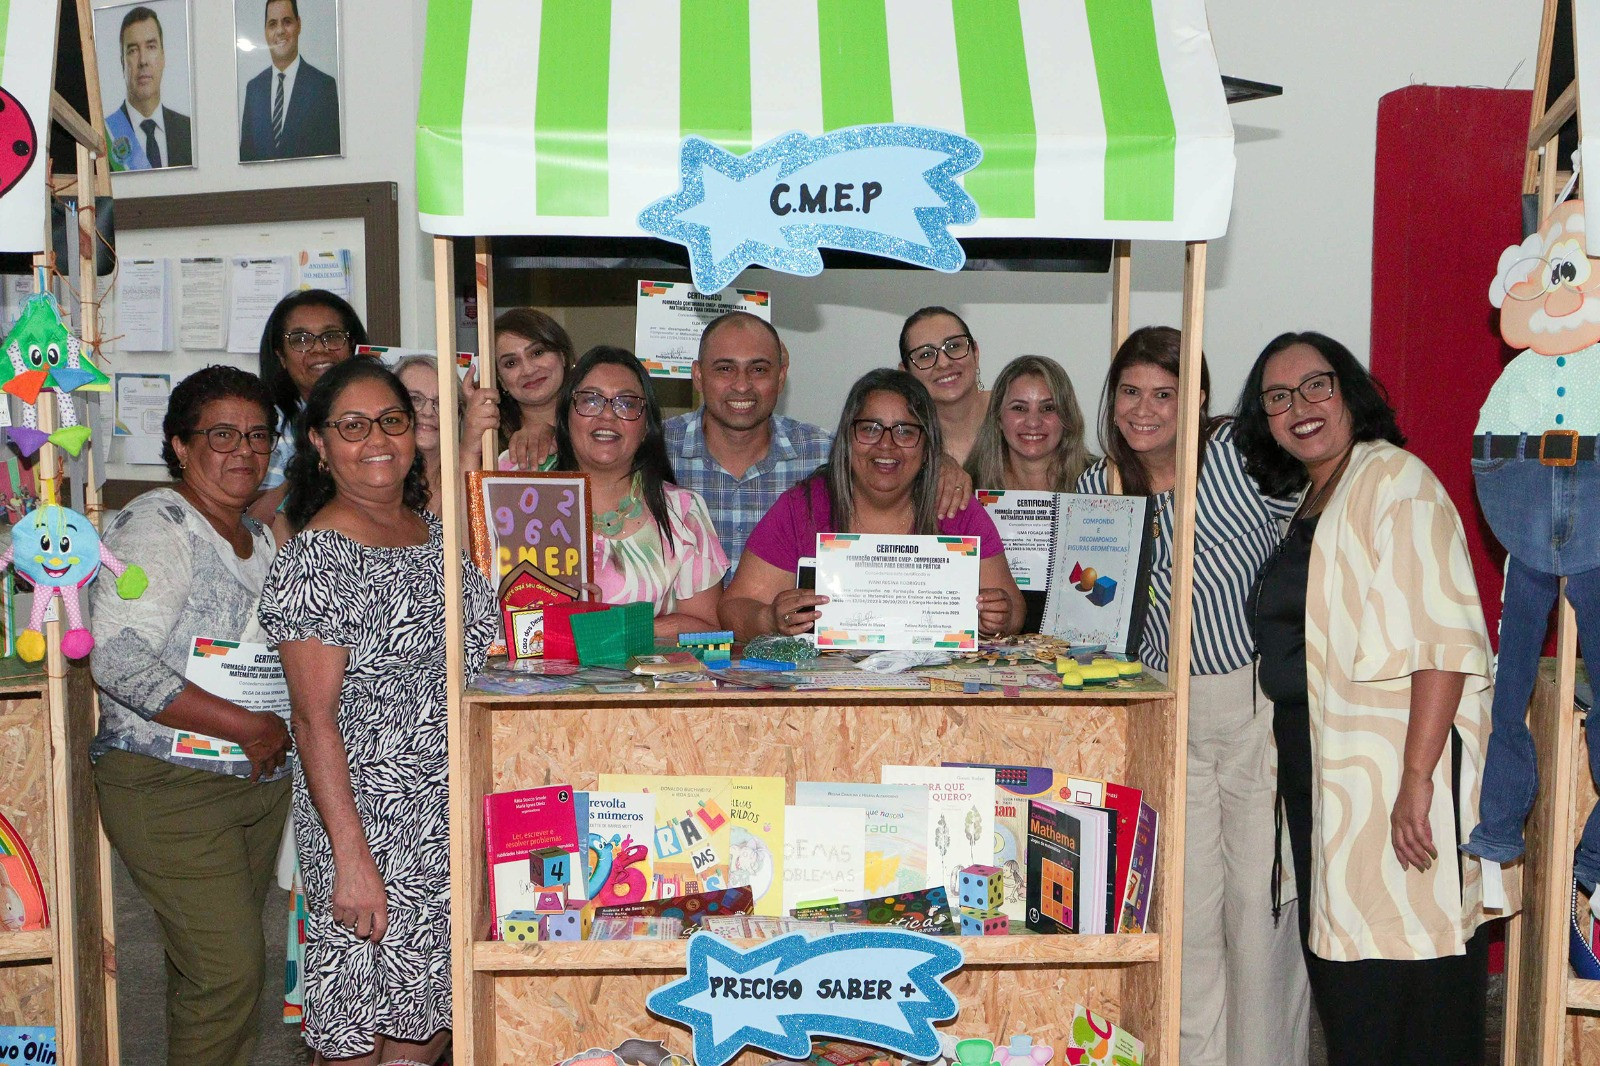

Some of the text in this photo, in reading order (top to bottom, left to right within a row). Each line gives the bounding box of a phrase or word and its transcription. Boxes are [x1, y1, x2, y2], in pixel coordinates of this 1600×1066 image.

[769, 181, 883, 216] C.M.E.P
[876, 544, 919, 554] CERTIFICADO
[1067, 543, 1128, 553] FIGURAS GEOMÉTRICAS
[530, 615, 544, 627] Desa
[221, 662, 247, 672] FORMAÇÃO
[944, 784, 965, 793] QUE
[932, 793, 972, 801] QUERO?
[589, 798, 626, 808] revolta
[598, 811, 644, 821] números
[865, 823, 898, 834] rado
[1030, 818, 1077, 851] Mathema
[505, 841, 530, 849] resolver
[530, 835, 562, 847] problemas
[692, 848, 716, 870] DAS
[551, 861, 564, 881] 4
[783, 867, 856, 882] OBLEMAS
[708, 976, 803, 1000] PRECISO
[816, 978, 892, 1001] SABER
